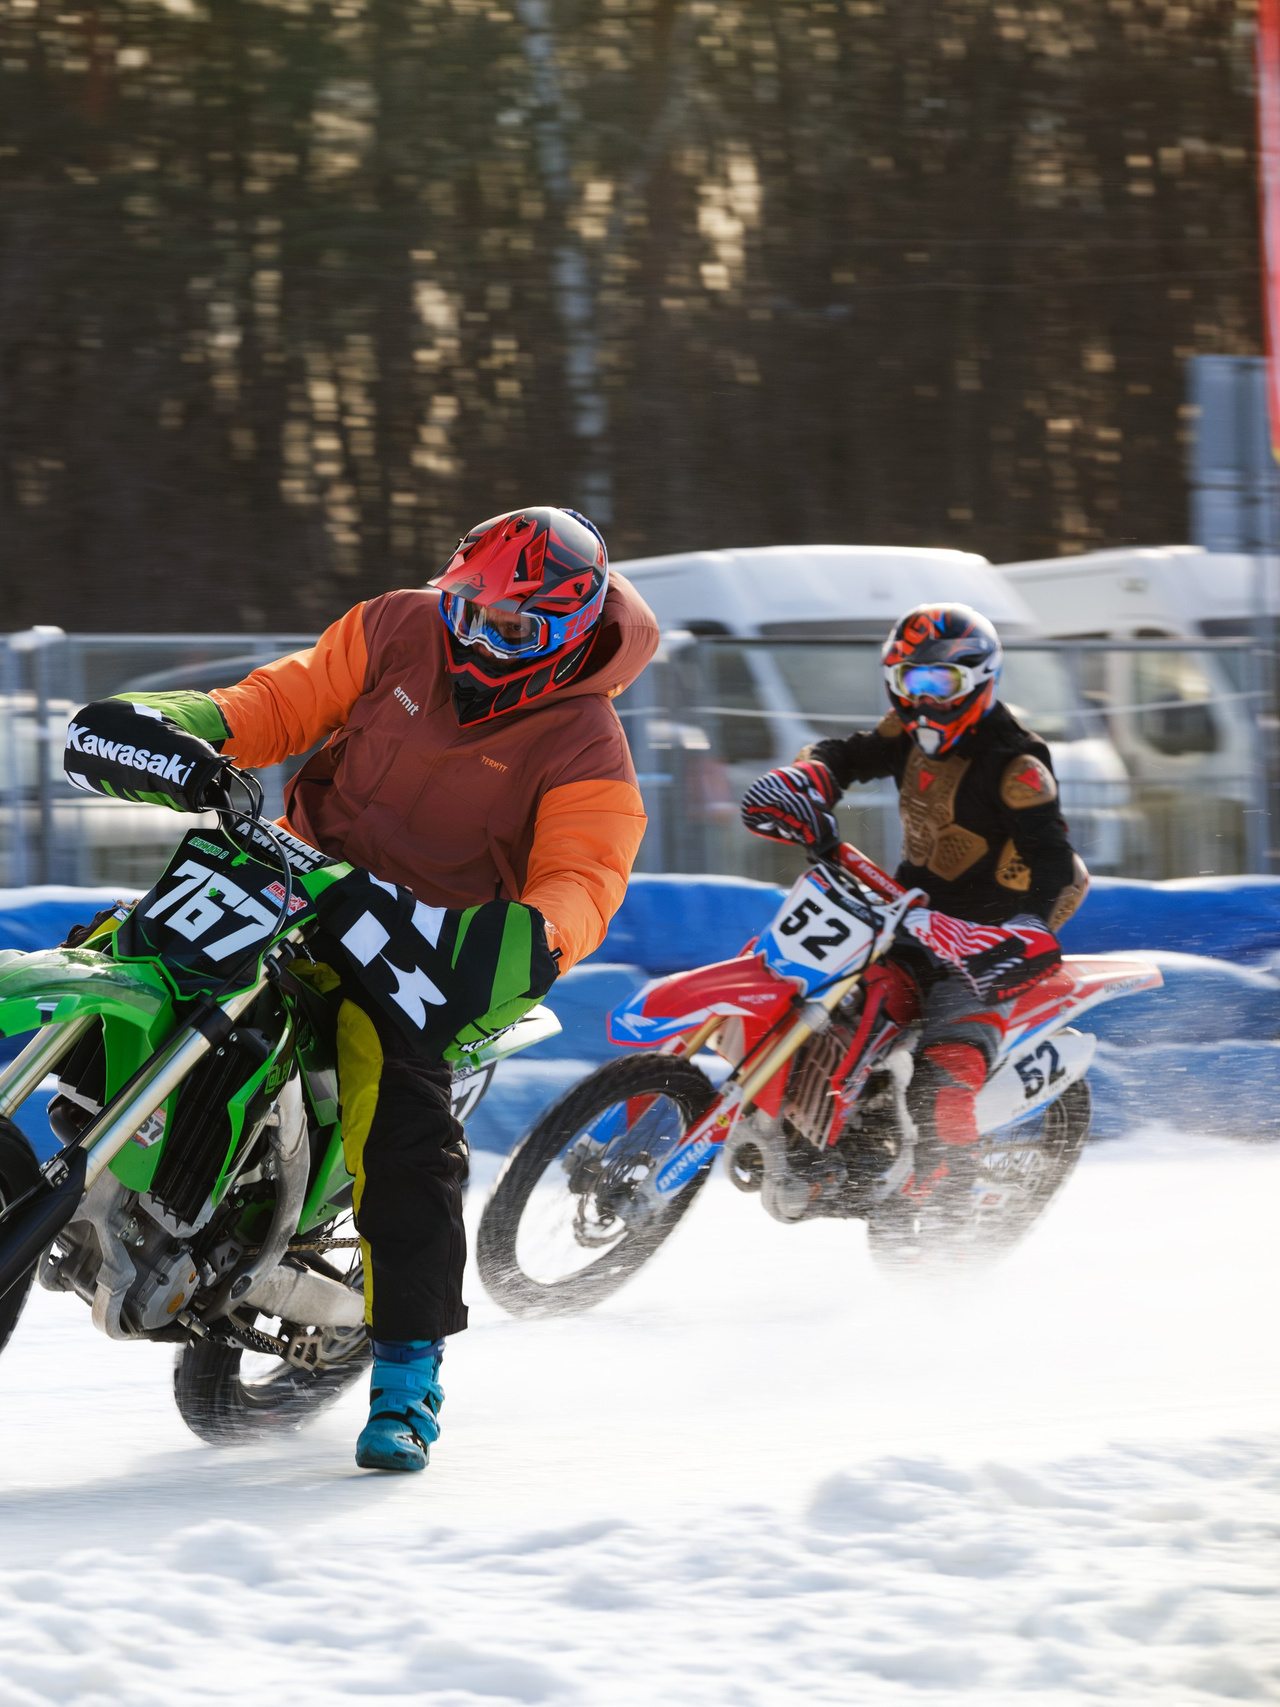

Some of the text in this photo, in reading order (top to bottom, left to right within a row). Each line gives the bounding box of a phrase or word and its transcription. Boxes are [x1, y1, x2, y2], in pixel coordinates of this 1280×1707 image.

[66, 722, 196, 787] Kawasaki
[145, 859, 280, 962] 767
[779, 898, 851, 961] 52
[1014, 1041, 1066, 1099] 52
[658, 1129, 714, 1190] DUNLOP
